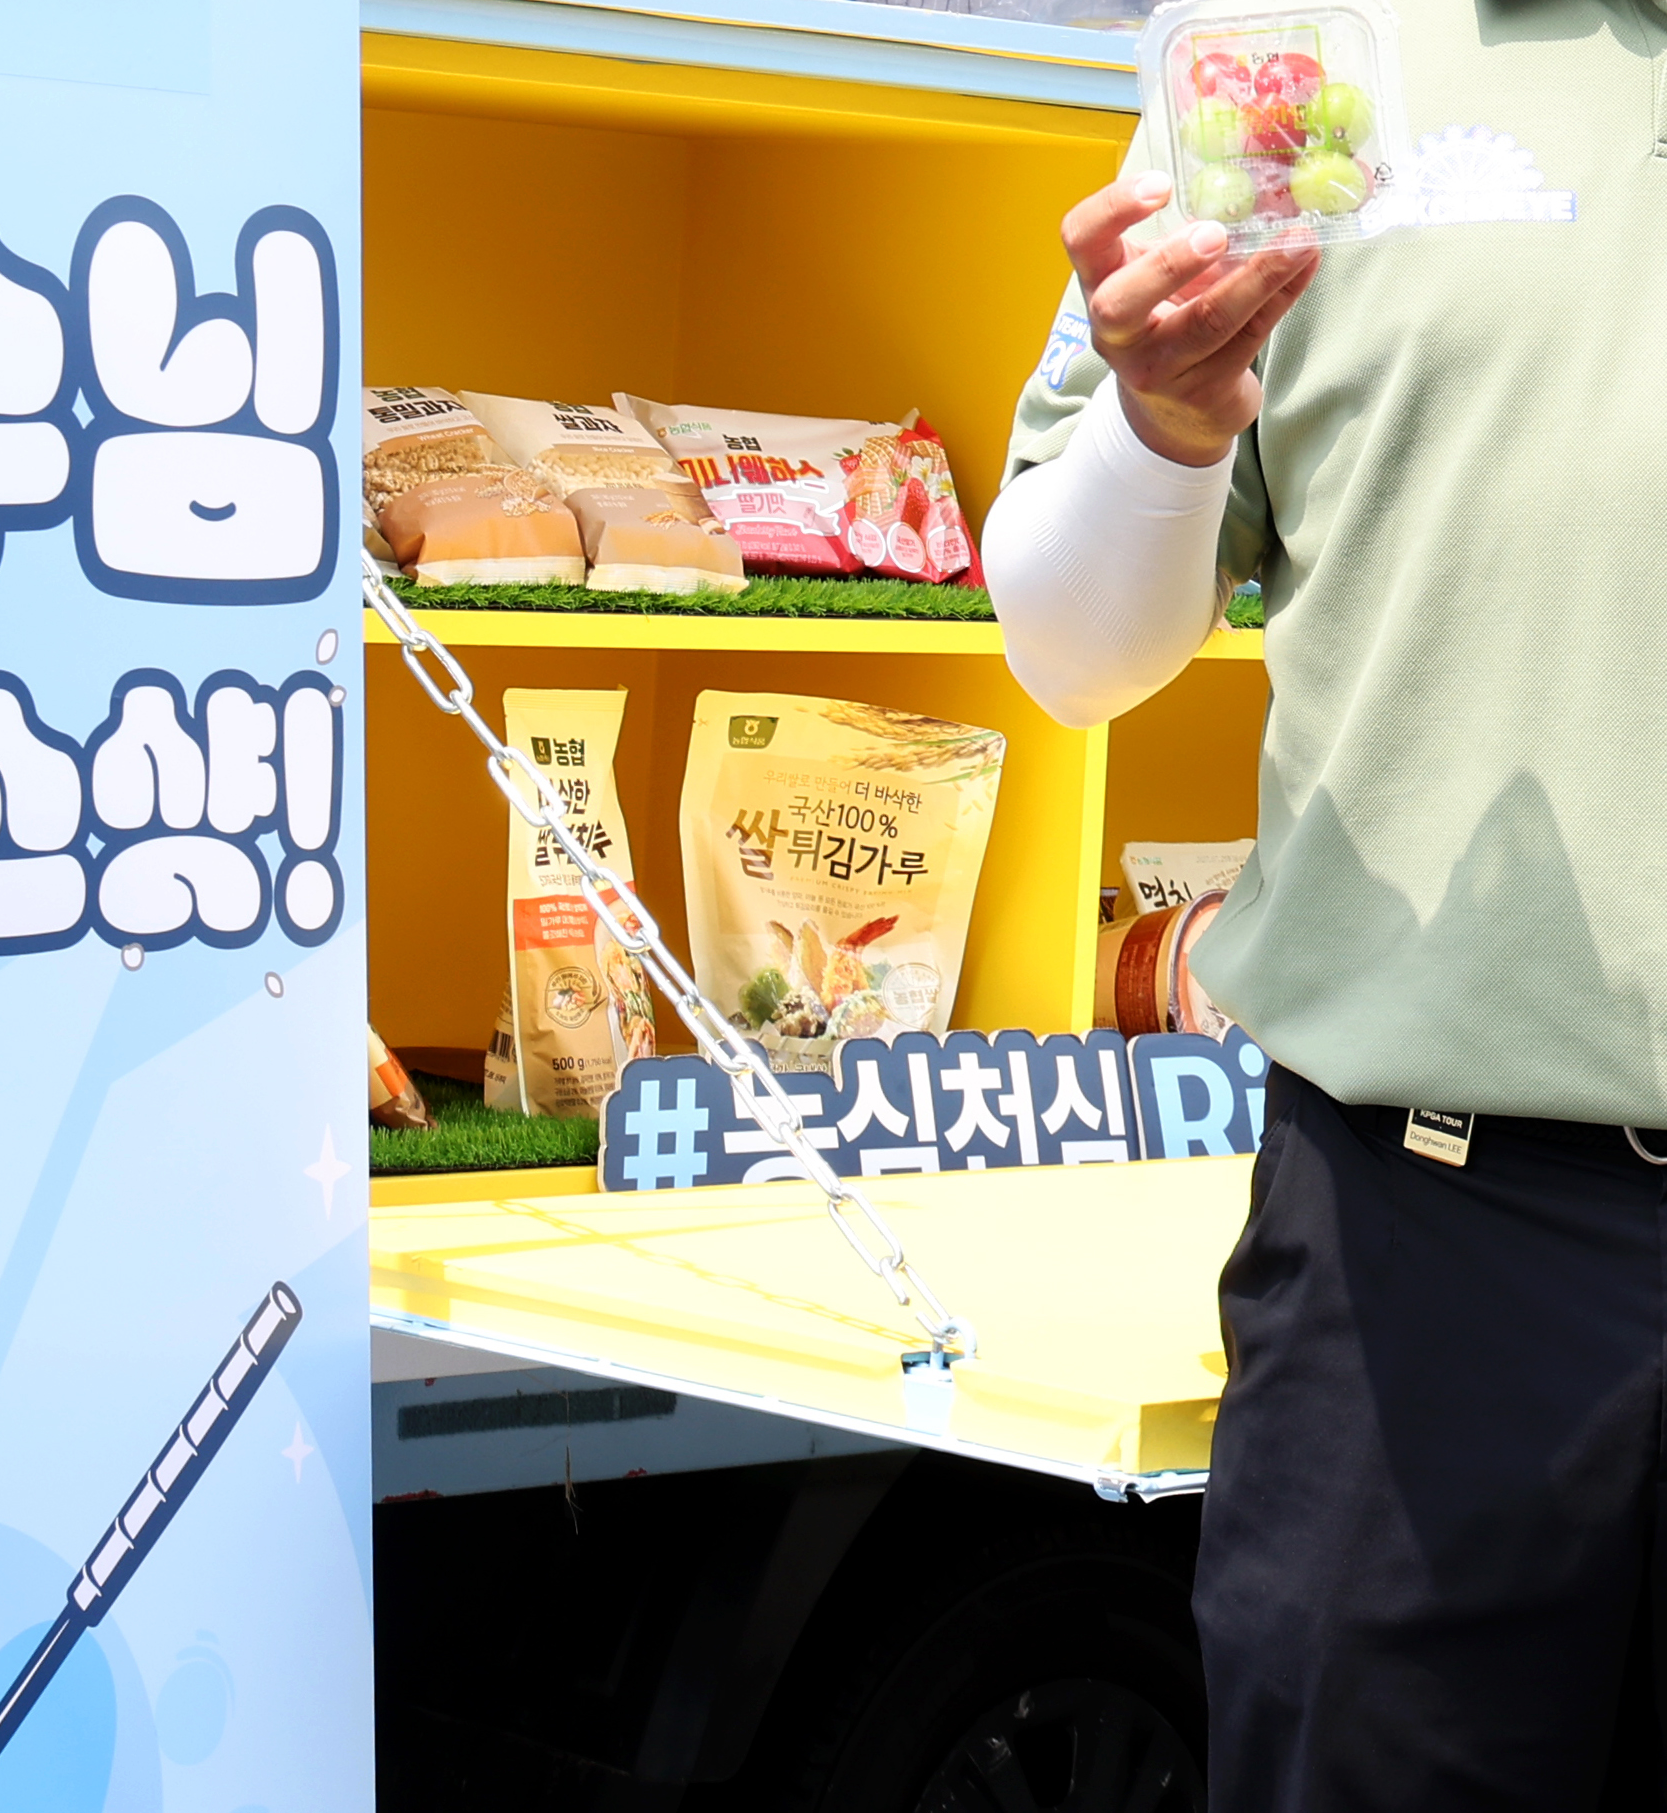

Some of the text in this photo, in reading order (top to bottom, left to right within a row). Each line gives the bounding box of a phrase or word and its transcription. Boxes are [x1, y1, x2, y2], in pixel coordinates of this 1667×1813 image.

[367, 399, 468, 424] 통밀과자
[553, 413, 624, 434] 쌀과자
[723, 434, 762, 452] 농협
[736, 492, 786, 514] 딸기맛
[553, 738, 585, 767] 농협
[855, 781, 870, 801] 더
[875, 786, 922, 815] 바삭한
[552, 1057, 574, 1071] 500
[1442, 1115, 1463, 1129] TOUR
[1410, 1131, 1462, 1154] Donghwan LEE
